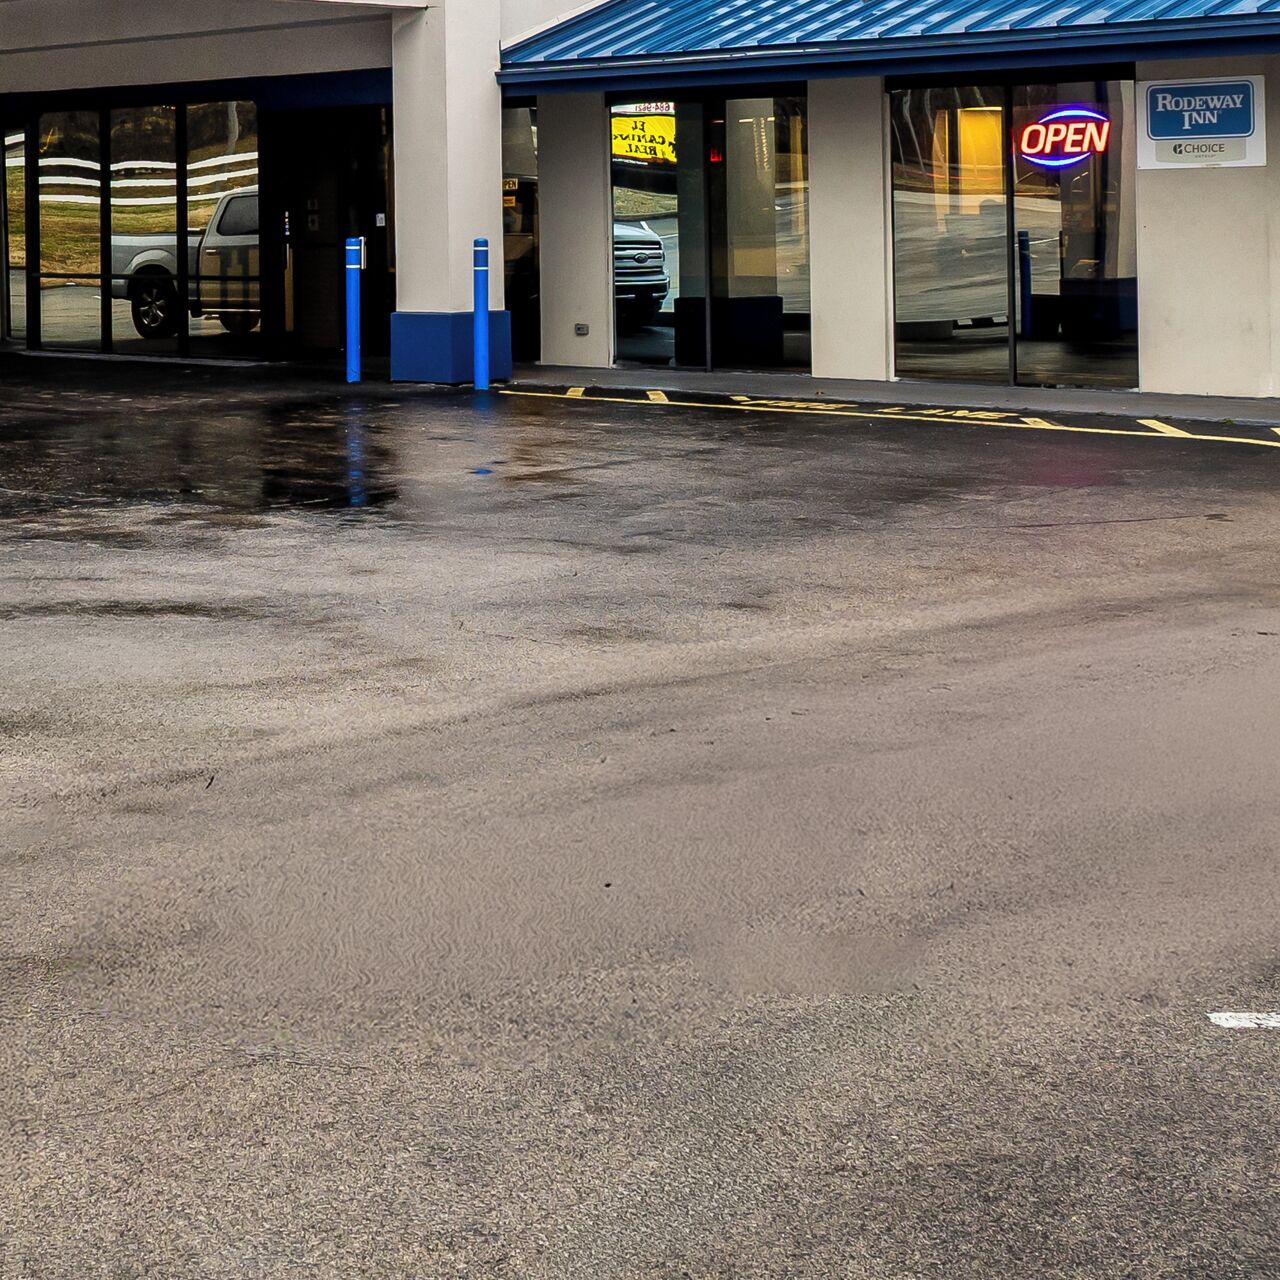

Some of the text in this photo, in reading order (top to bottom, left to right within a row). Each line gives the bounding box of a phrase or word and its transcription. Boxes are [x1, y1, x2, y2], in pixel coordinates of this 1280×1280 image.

[1156, 93, 1244, 112] RODEWAY
[1182, 110, 1218, 130] INN
[1020, 121, 1110, 154] OPEN
[1183, 143, 1225, 154] CHOICE
